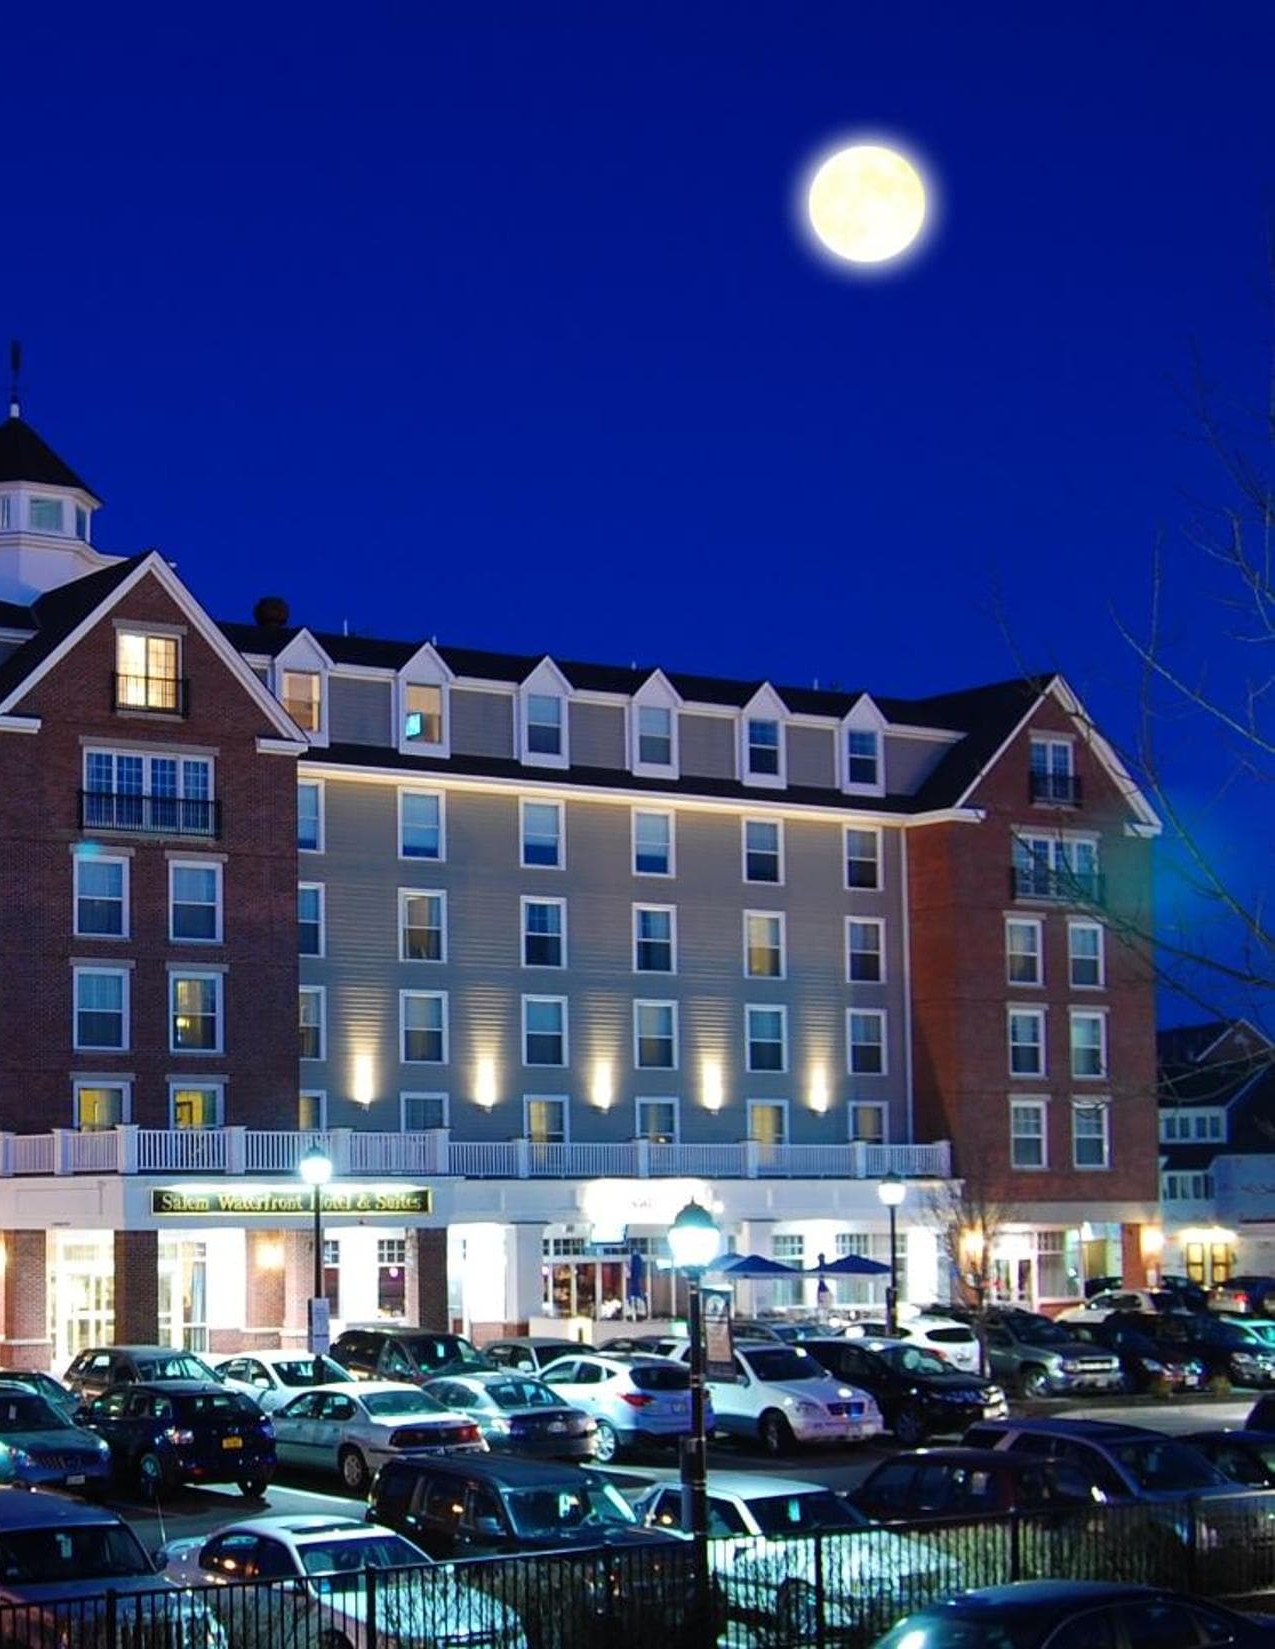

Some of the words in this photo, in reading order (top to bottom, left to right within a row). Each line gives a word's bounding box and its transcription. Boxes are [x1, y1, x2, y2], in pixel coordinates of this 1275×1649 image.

[162, 1194, 209, 1211] Salem
[218, 1194, 303, 1211] Waterfront
[357, 1193, 370, 1210] &
[376, 1193, 421, 1210] Suites
